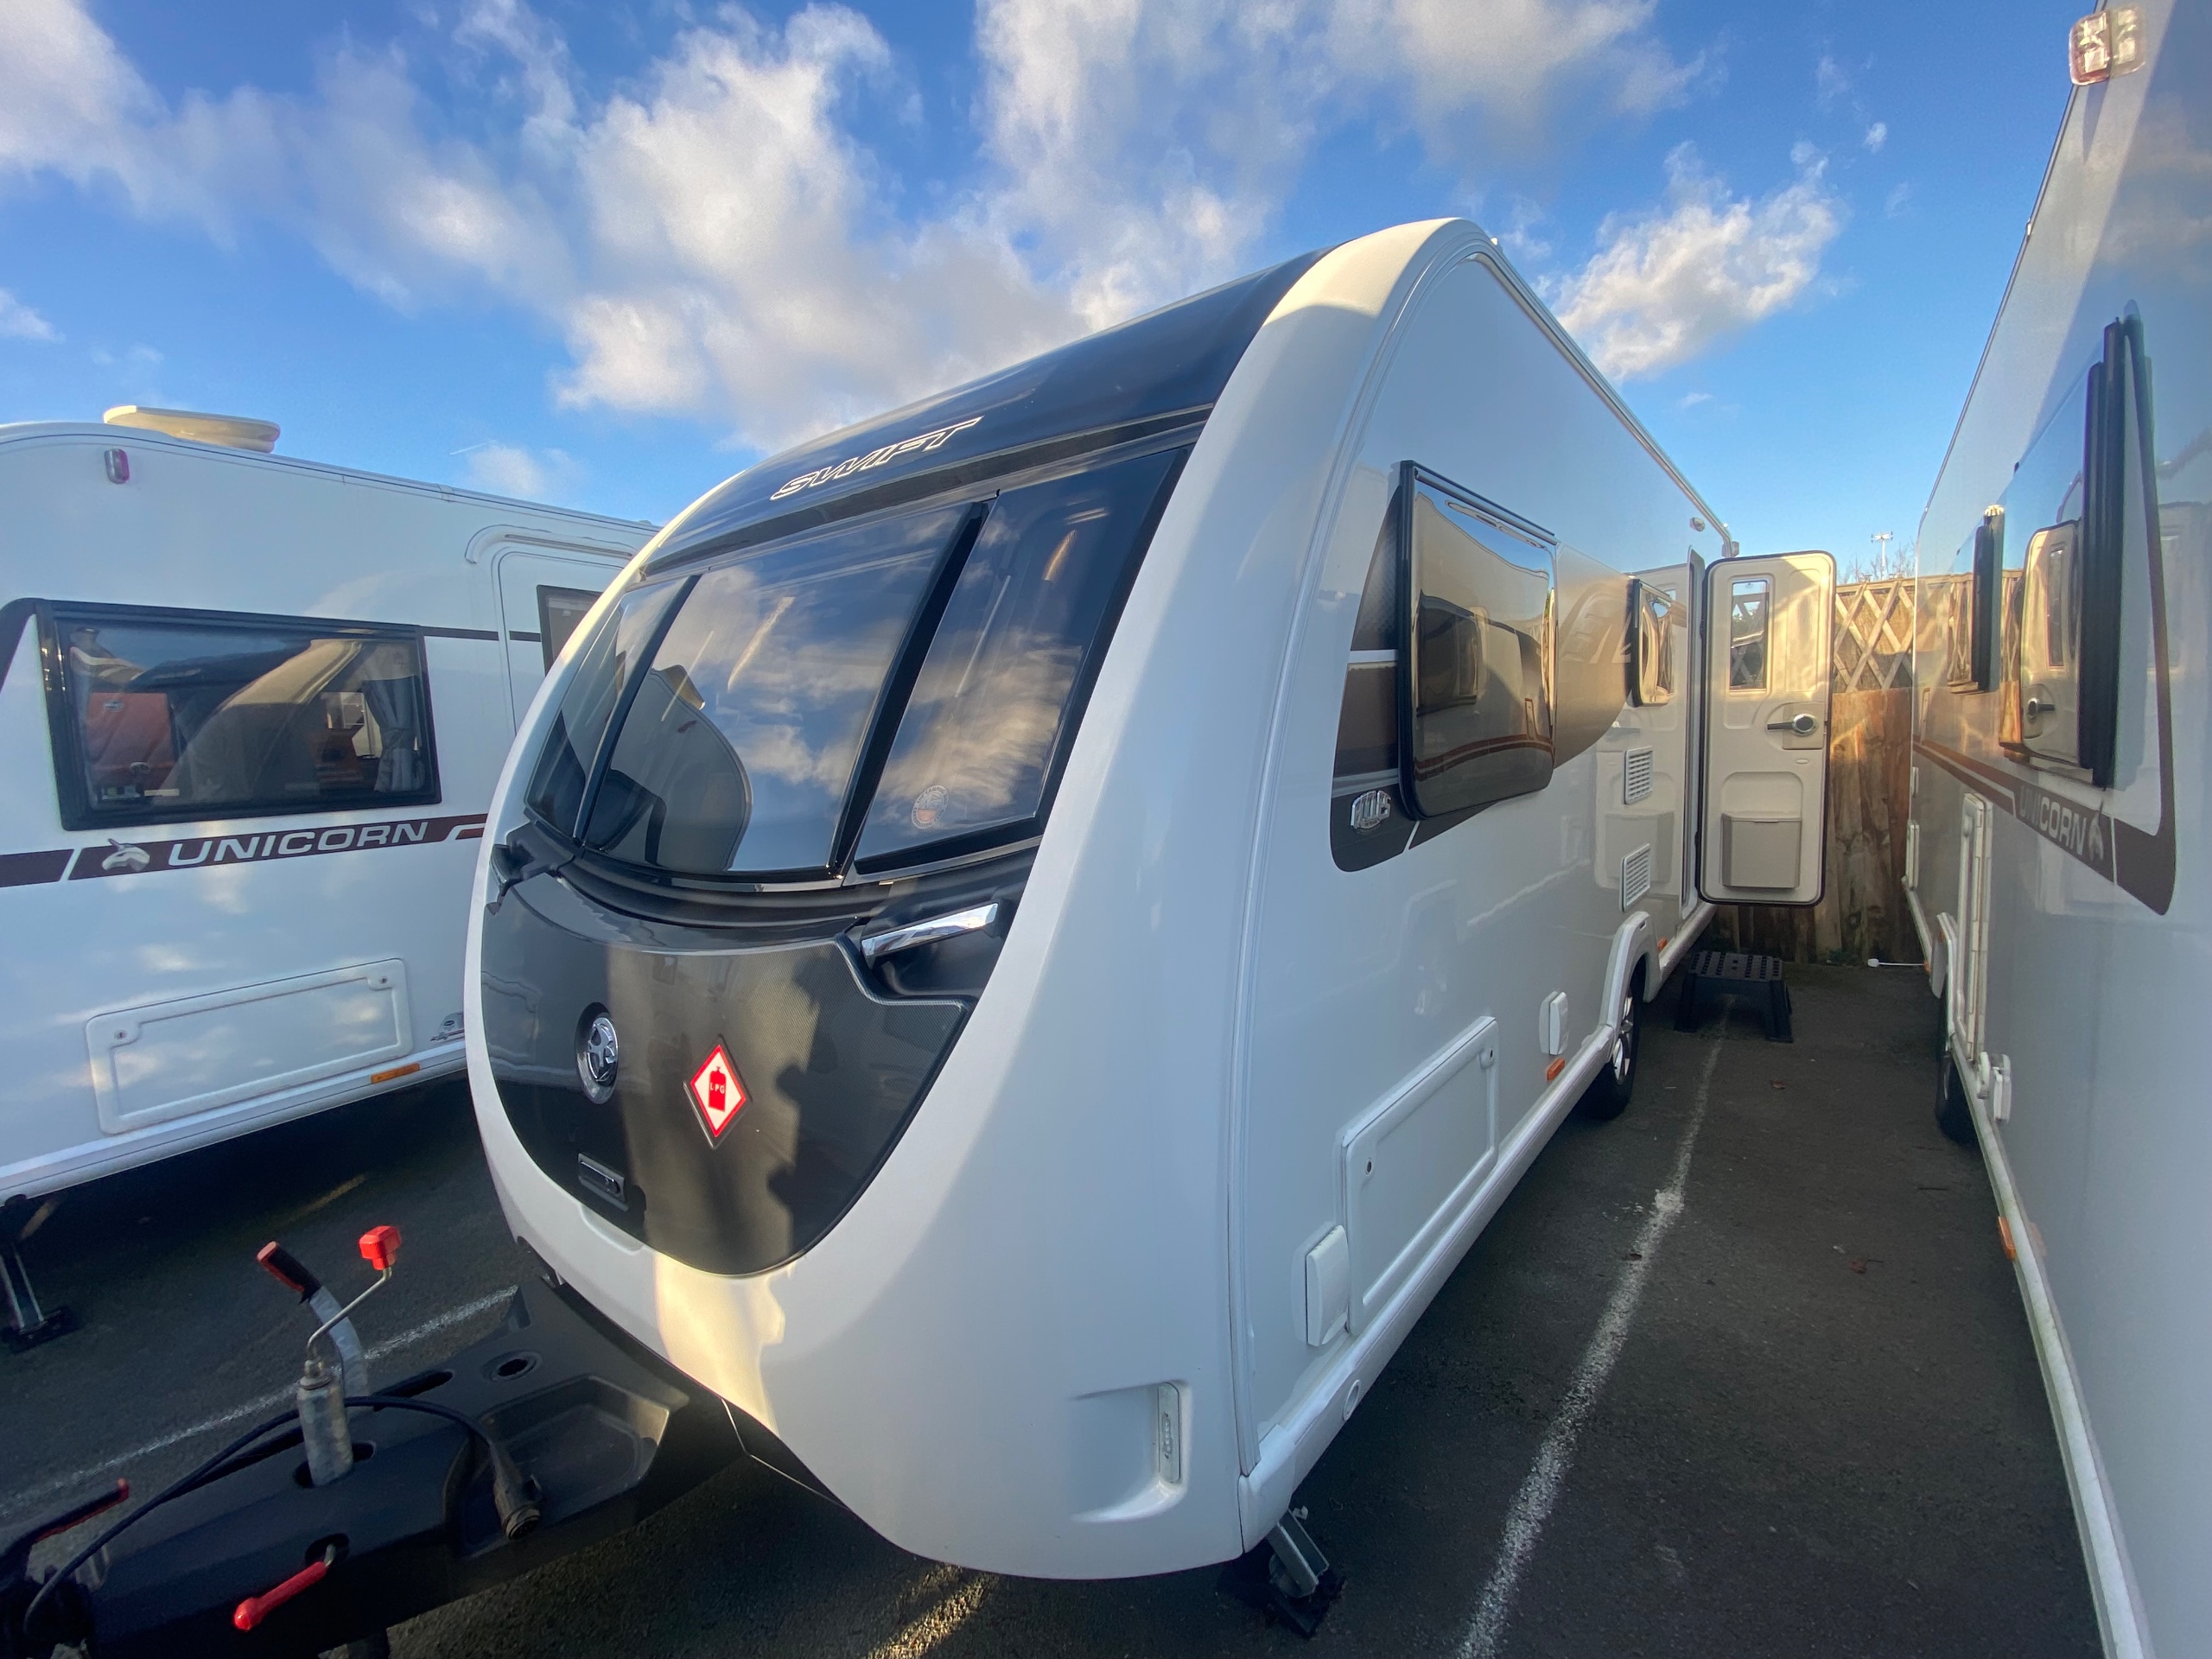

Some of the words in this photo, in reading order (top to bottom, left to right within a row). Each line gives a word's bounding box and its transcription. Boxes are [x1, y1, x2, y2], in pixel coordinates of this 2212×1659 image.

[770, 416, 984, 500] SWIFT
[168, 822, 429, 867] UNICORN
[2019, 785, 2087, 856] UNICORN
[709, 1082, 725, 1094] LPG
